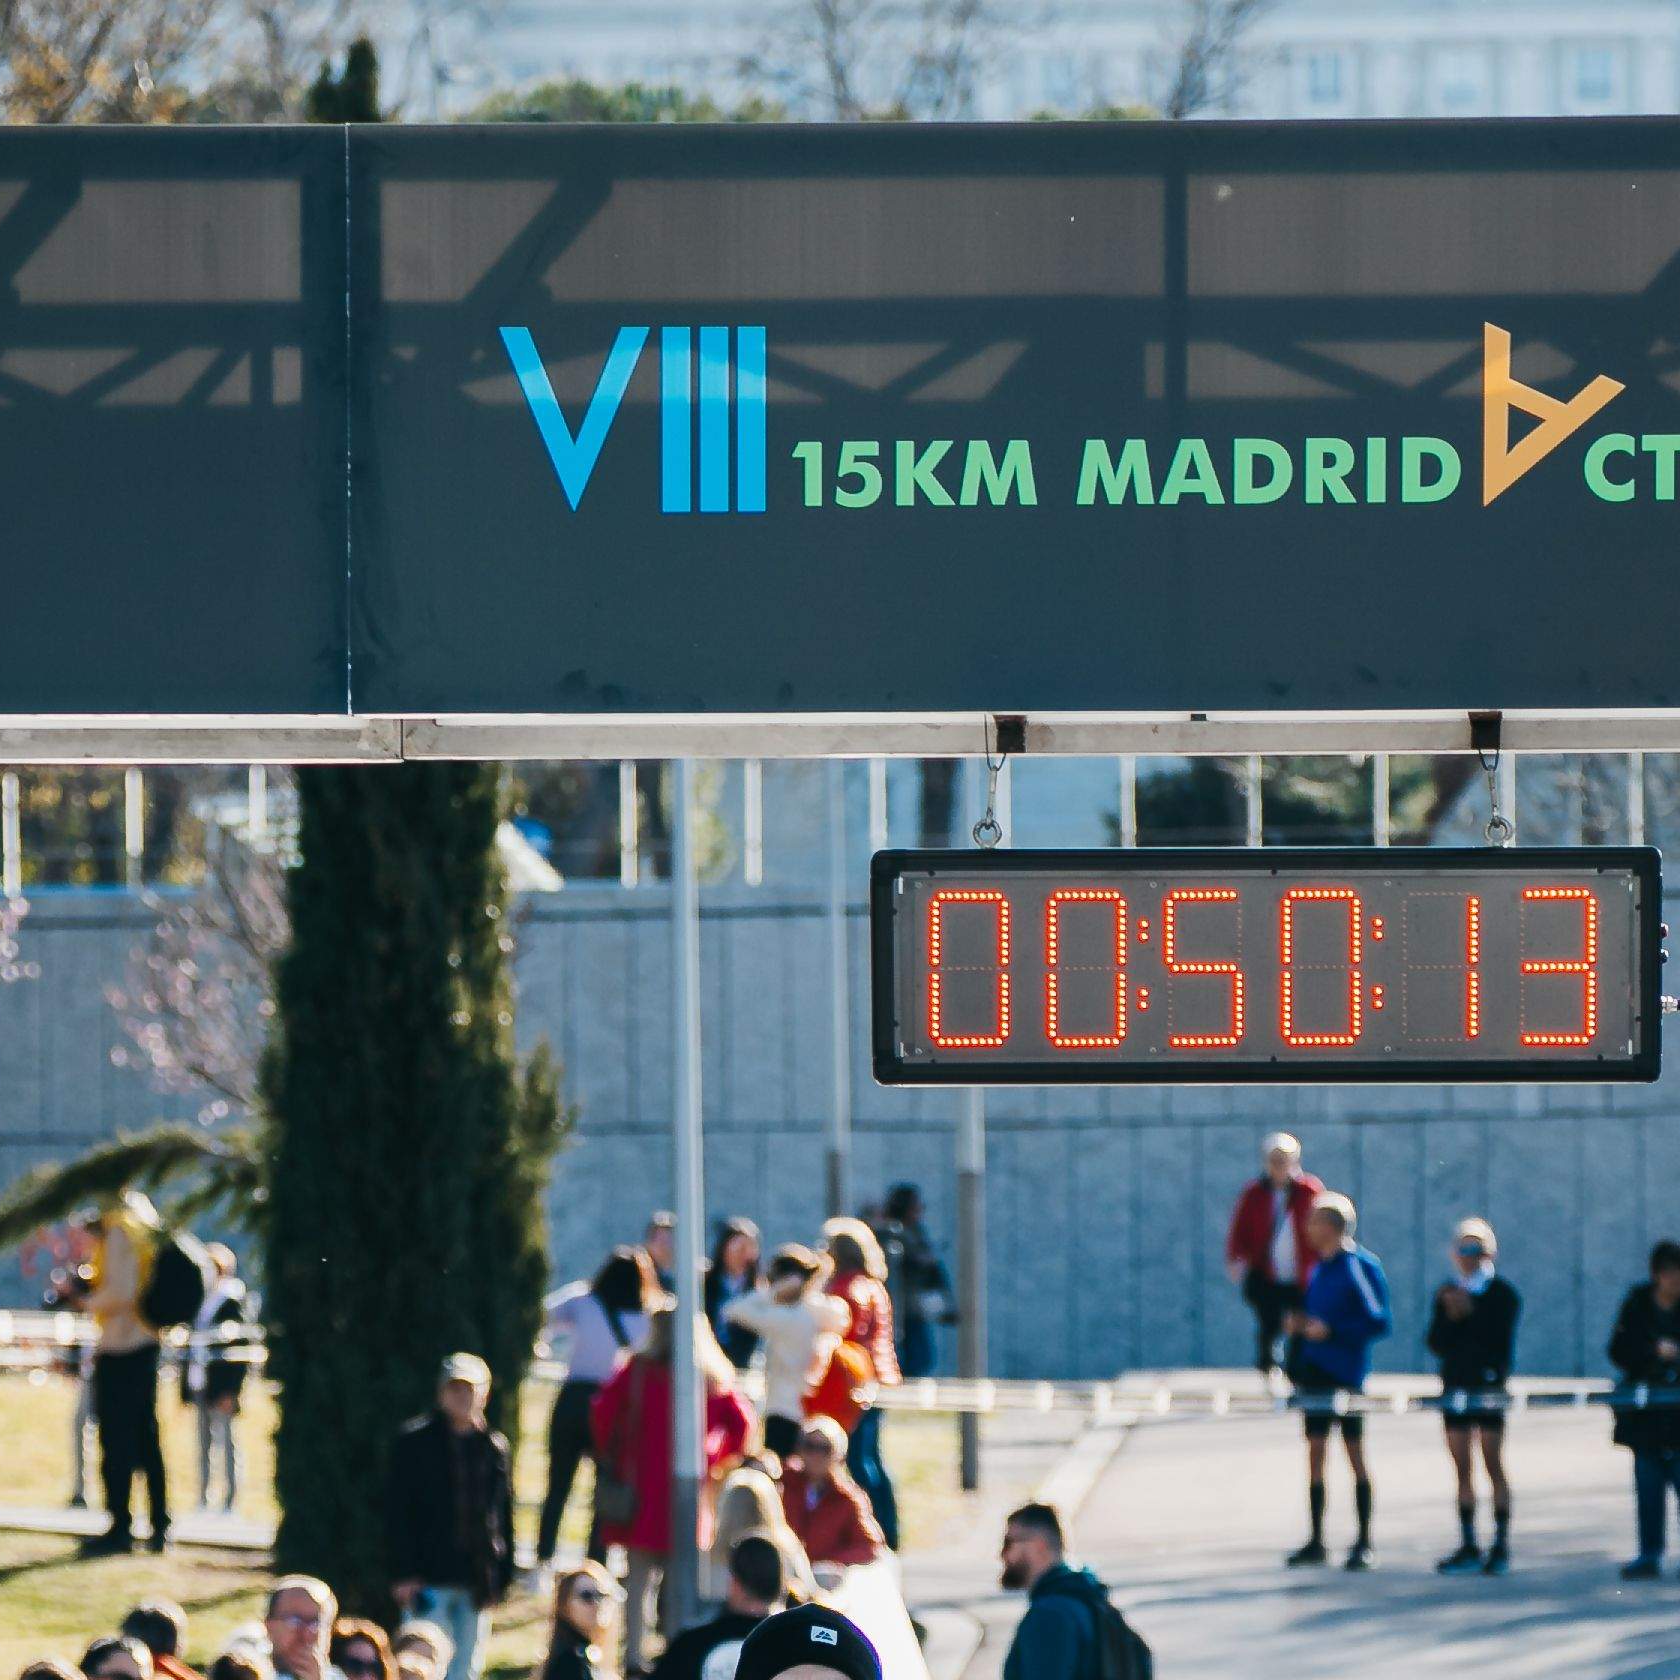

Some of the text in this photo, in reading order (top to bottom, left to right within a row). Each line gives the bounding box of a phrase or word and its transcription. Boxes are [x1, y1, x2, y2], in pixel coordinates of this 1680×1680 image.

[498, 325, 767, 513] VIII
[791, 439, 1039, 508] 15KM
[1075, 436, 1462, 506] MADRID
[928, 887, 1598, 1048] 00:50:13
